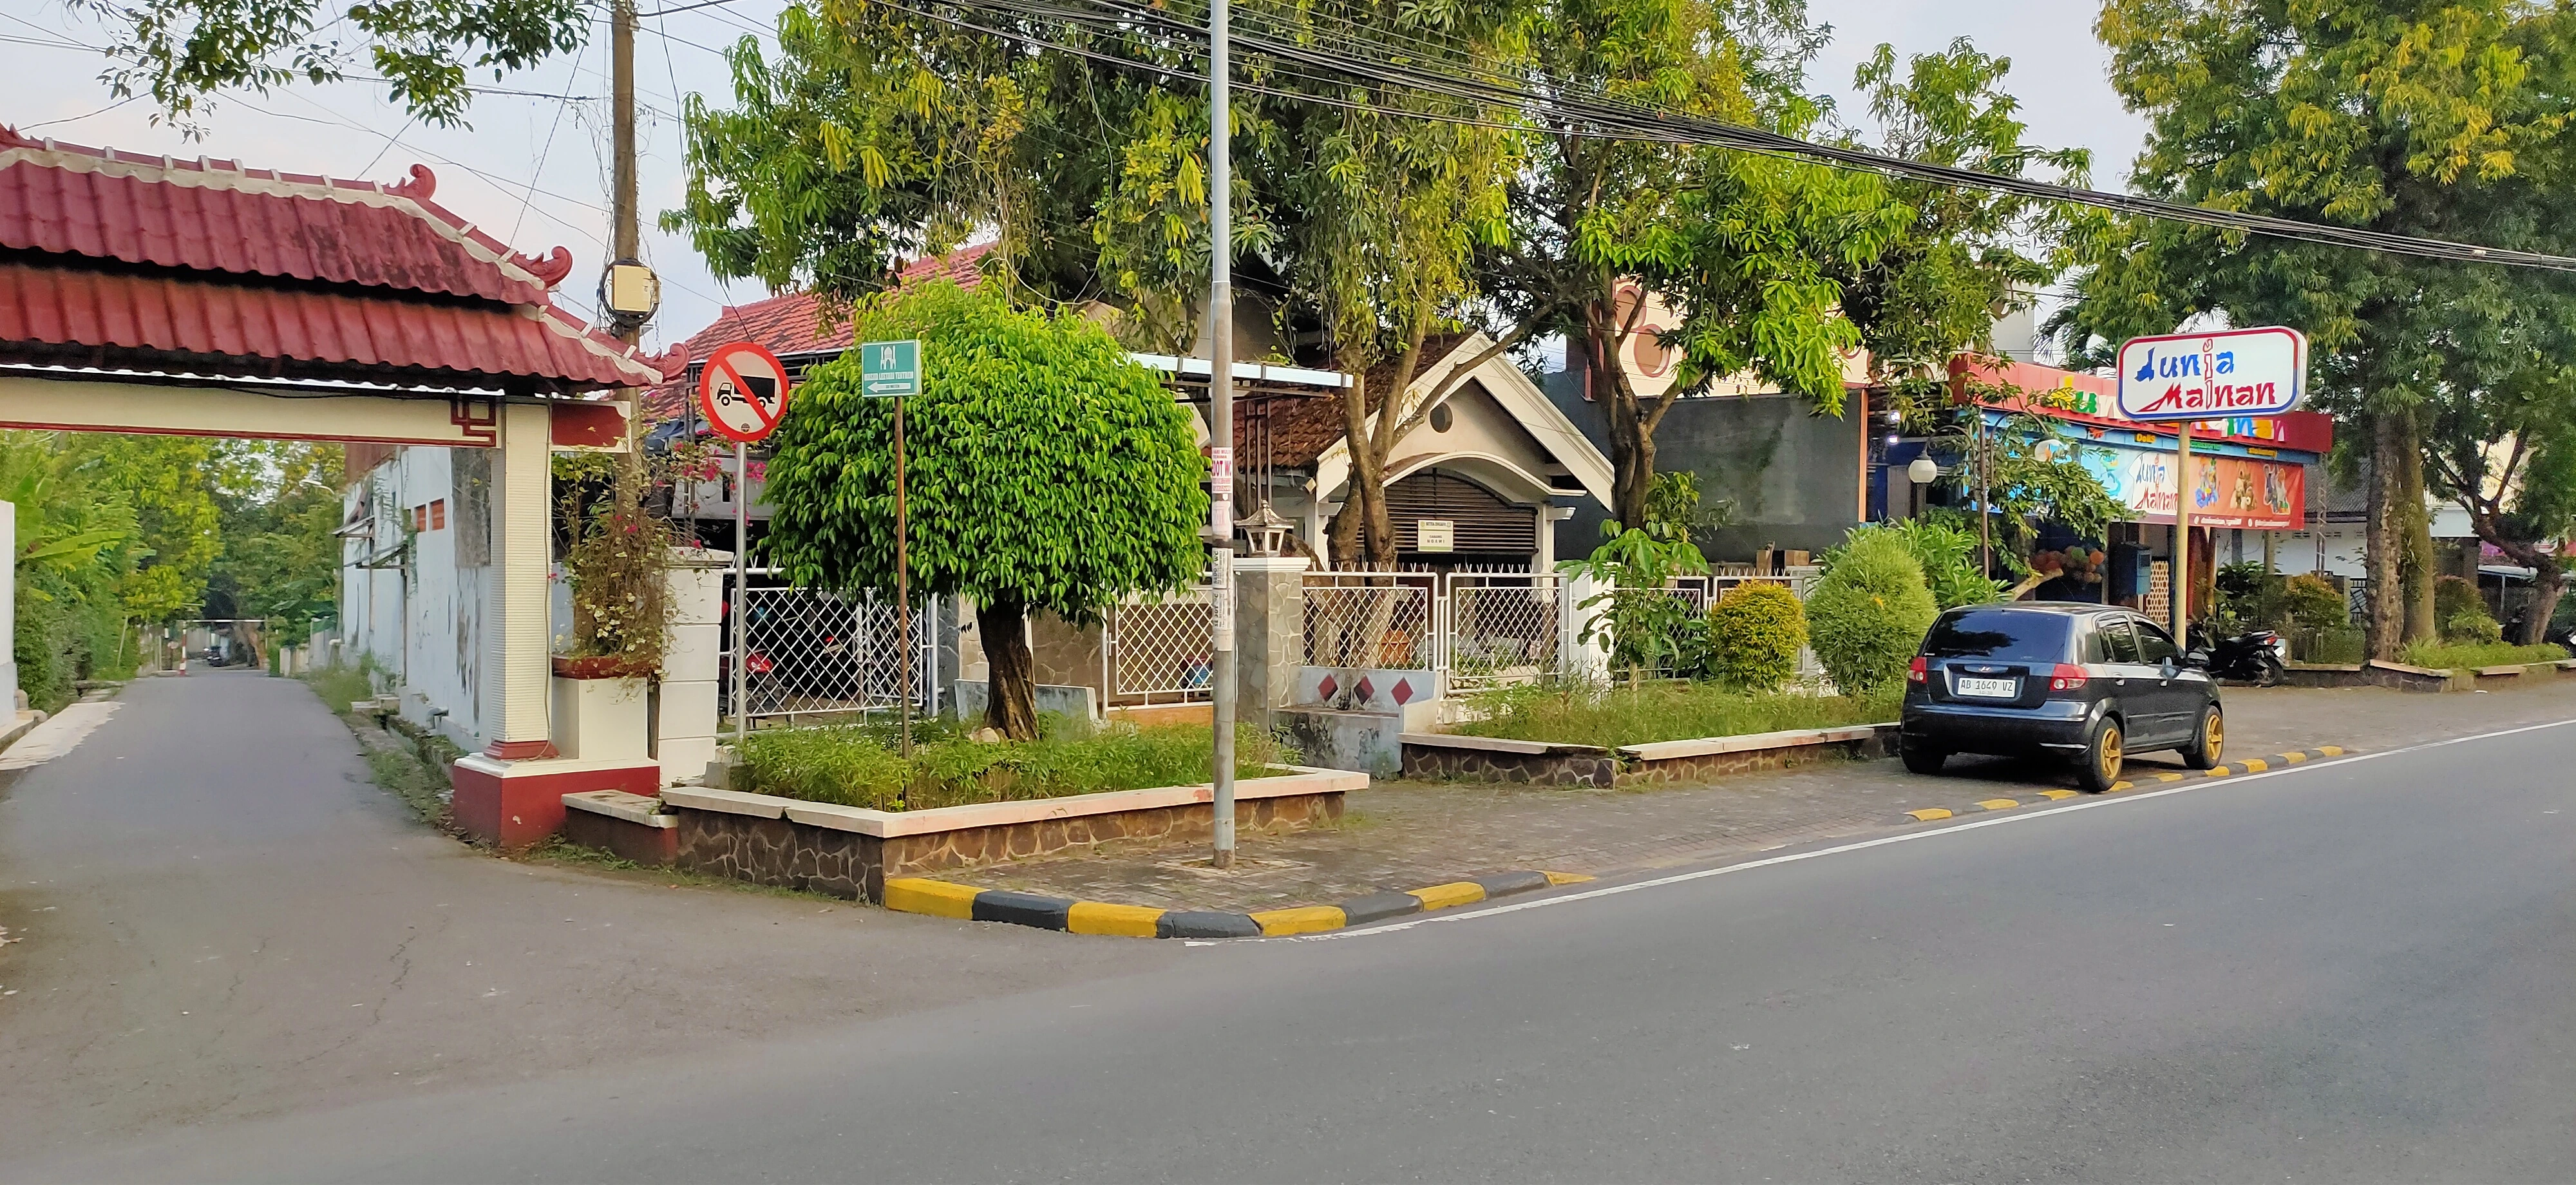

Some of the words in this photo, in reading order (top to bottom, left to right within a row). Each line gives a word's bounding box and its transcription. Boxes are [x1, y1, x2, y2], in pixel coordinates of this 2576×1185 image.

[2135, 380, 2278, 413] Mainan
[2136, 433, 2156, 444] Dolls
[1960, 679, 1971, 689] AB
[2002, 681, 2013, 692] VZ
